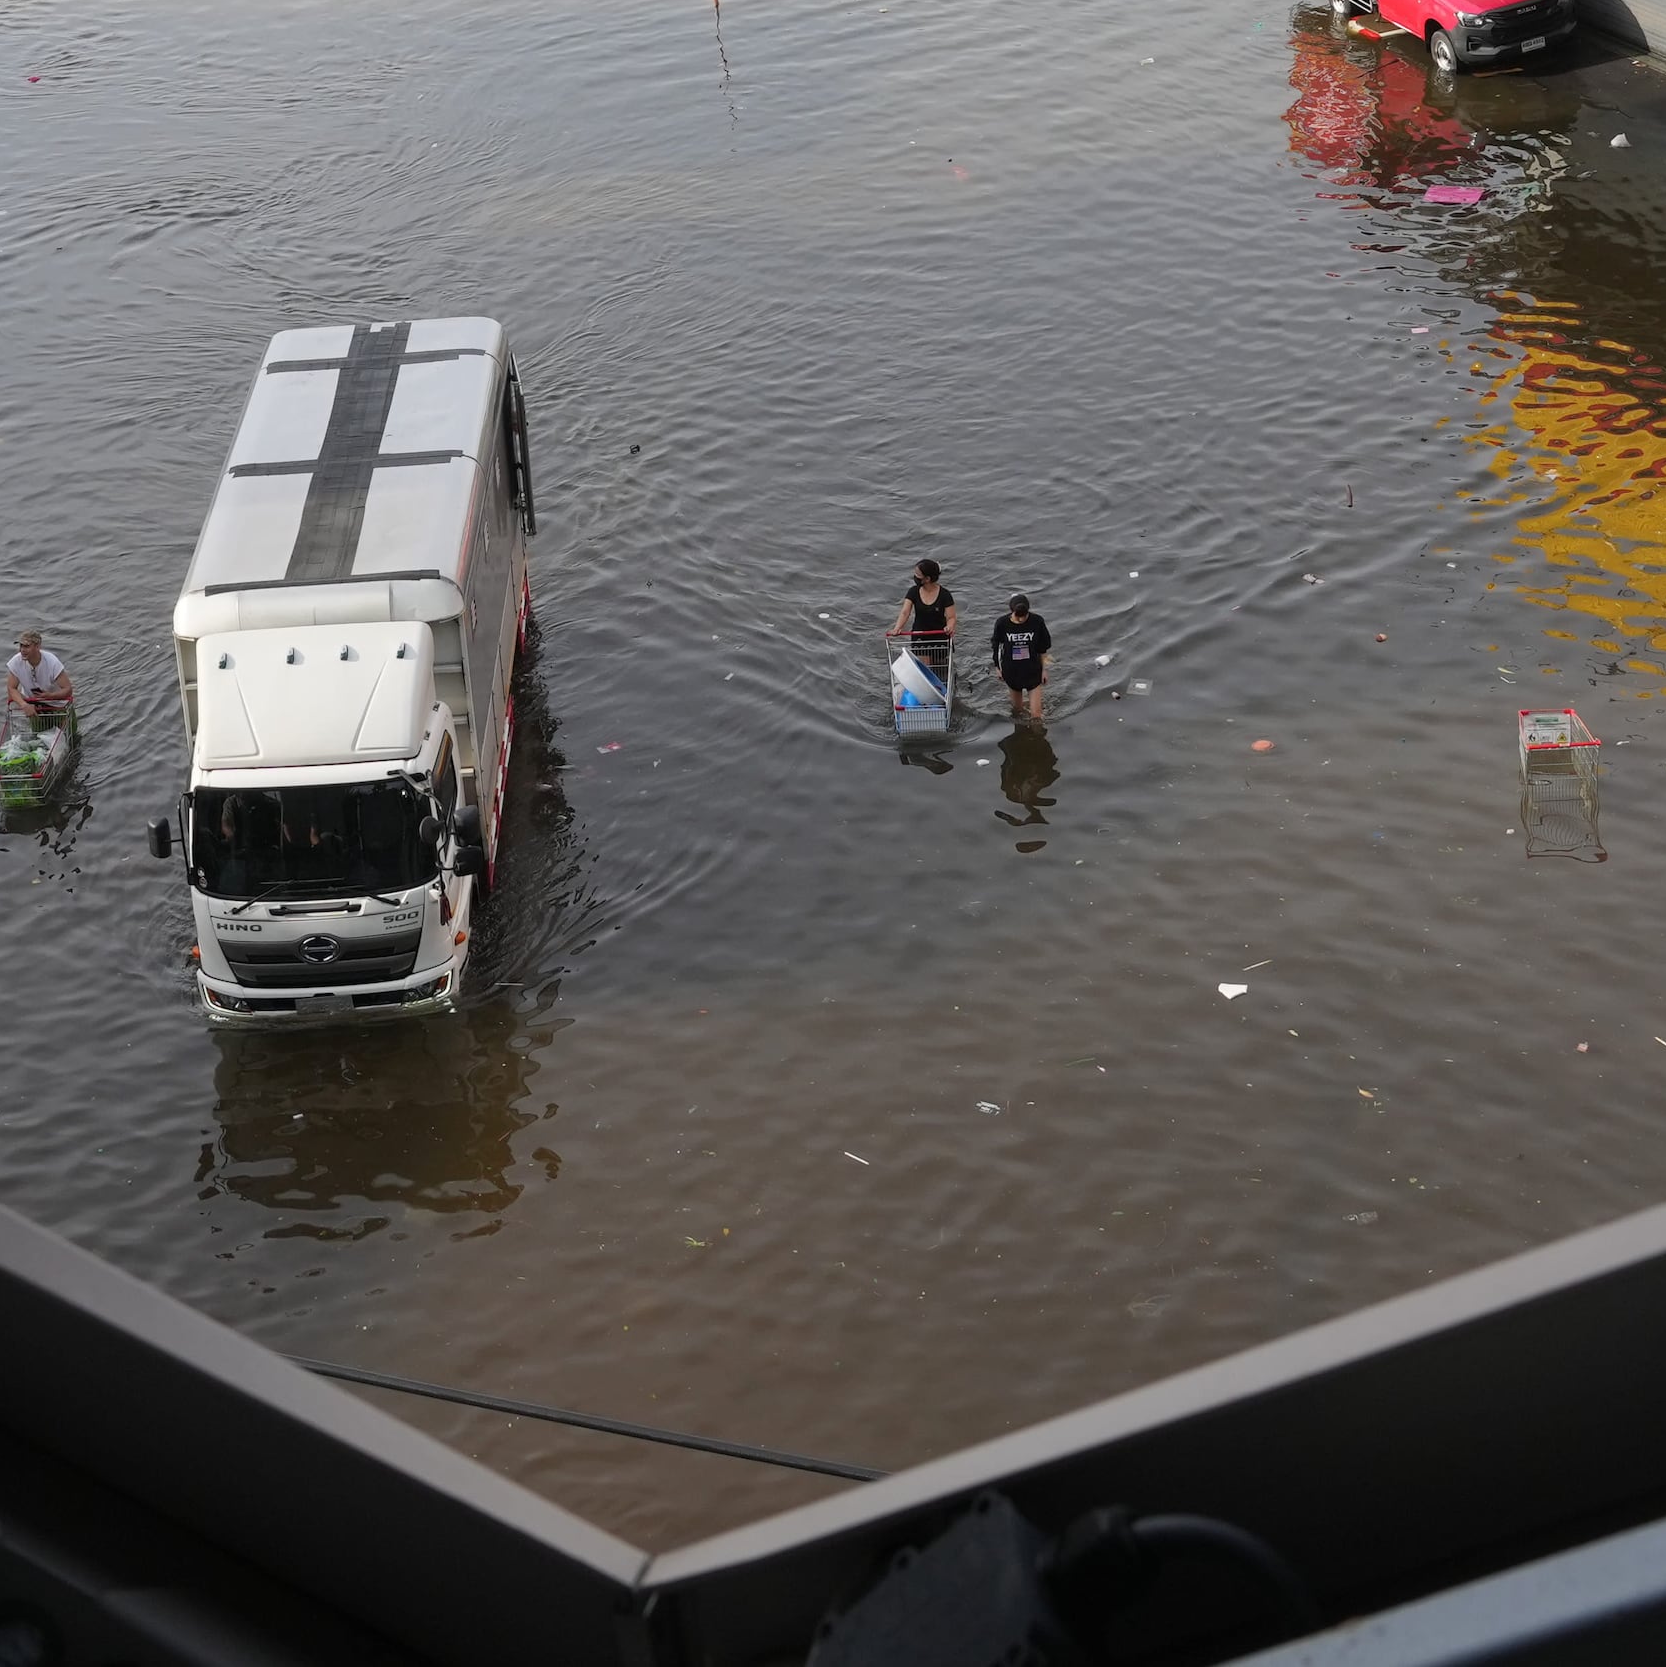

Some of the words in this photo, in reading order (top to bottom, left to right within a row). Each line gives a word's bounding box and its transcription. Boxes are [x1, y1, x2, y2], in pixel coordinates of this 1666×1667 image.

[1006, 632, 1034, 642] YEEZY
[383, 910, 419, 924] 500
[216, 923, 263, 933] HINO
